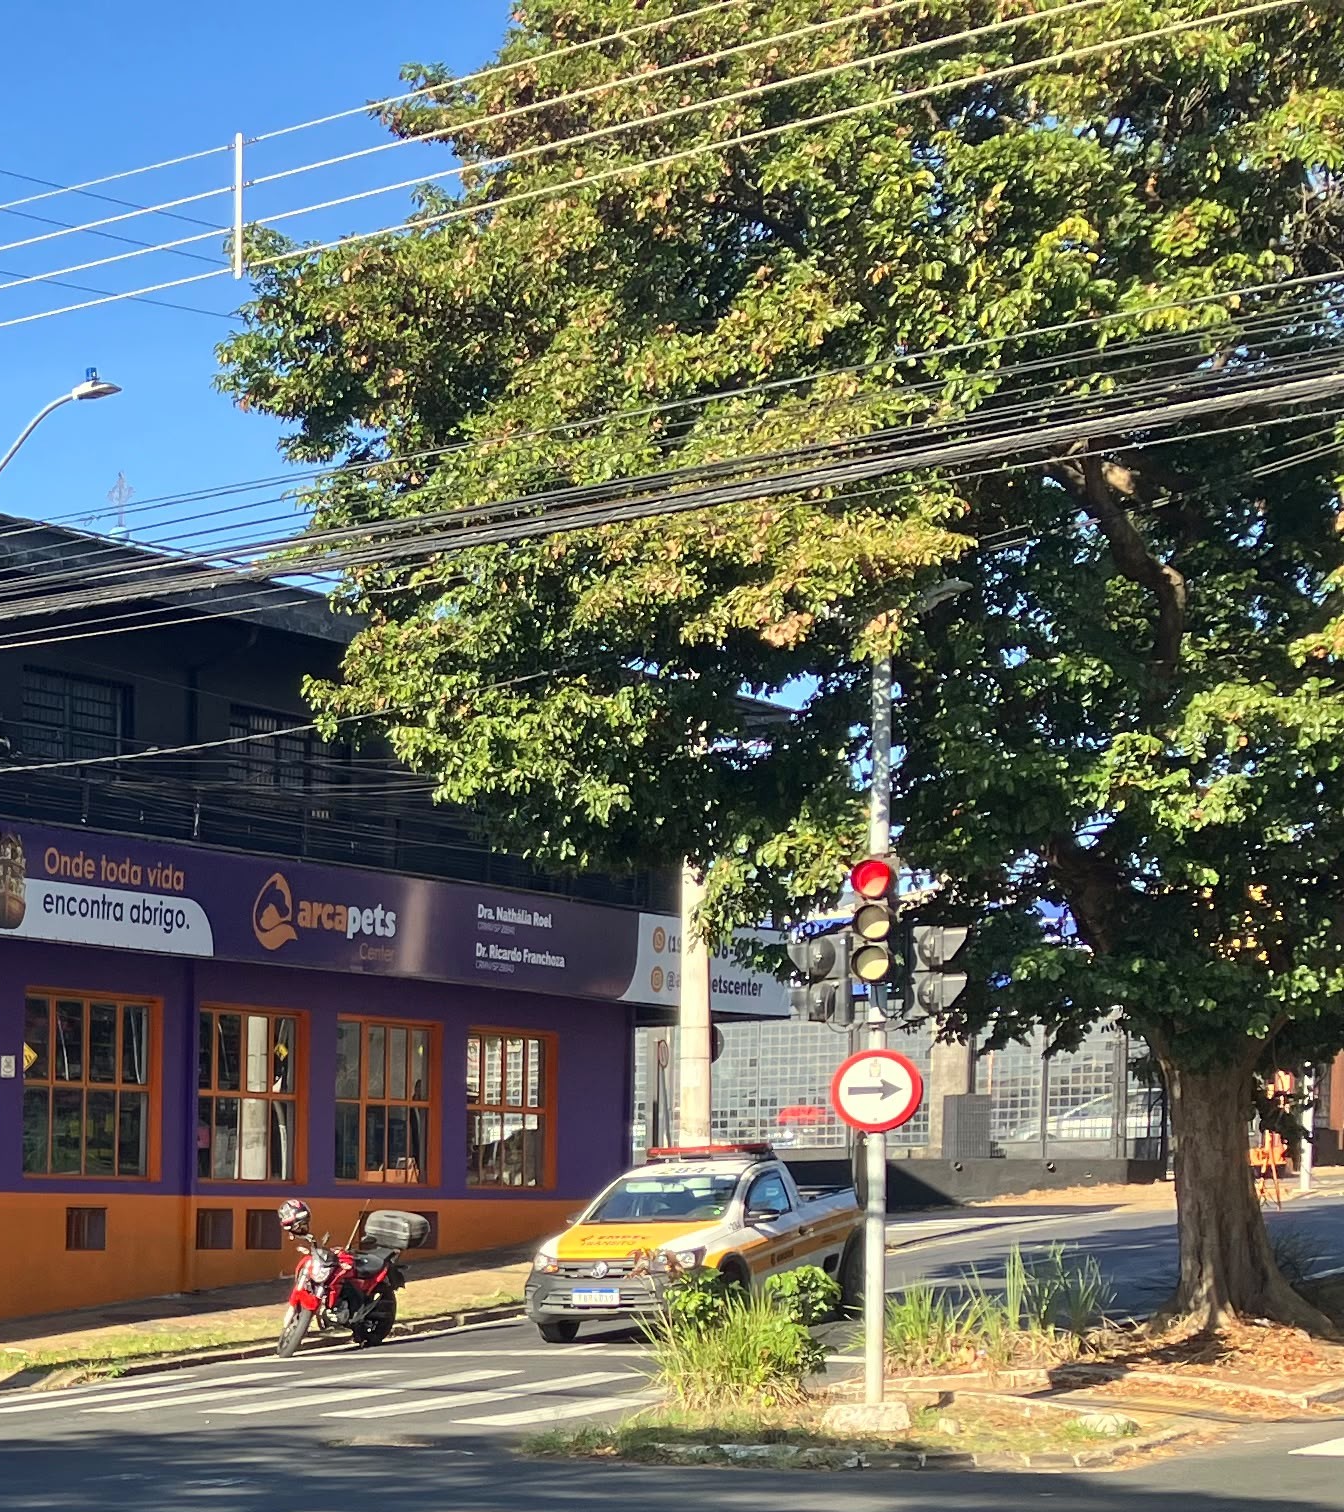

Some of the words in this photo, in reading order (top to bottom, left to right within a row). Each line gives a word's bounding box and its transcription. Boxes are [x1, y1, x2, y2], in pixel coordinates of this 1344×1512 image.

[44, 847, 95, 879] Onde
[101, 854, 141, 886] toda
[148, 862, 185, 891] vida
[43, 893, 123, 922] encontra
[130, 899, 190, 934] abrigo.
[297, 900, 396, 939] arcapets
[478, 904, 495, 919] Dra.
[359, 943, 395, 961] Center
[476, 943, 488, 957] Dr.
[489, 945, 522, 962] Ricardo
